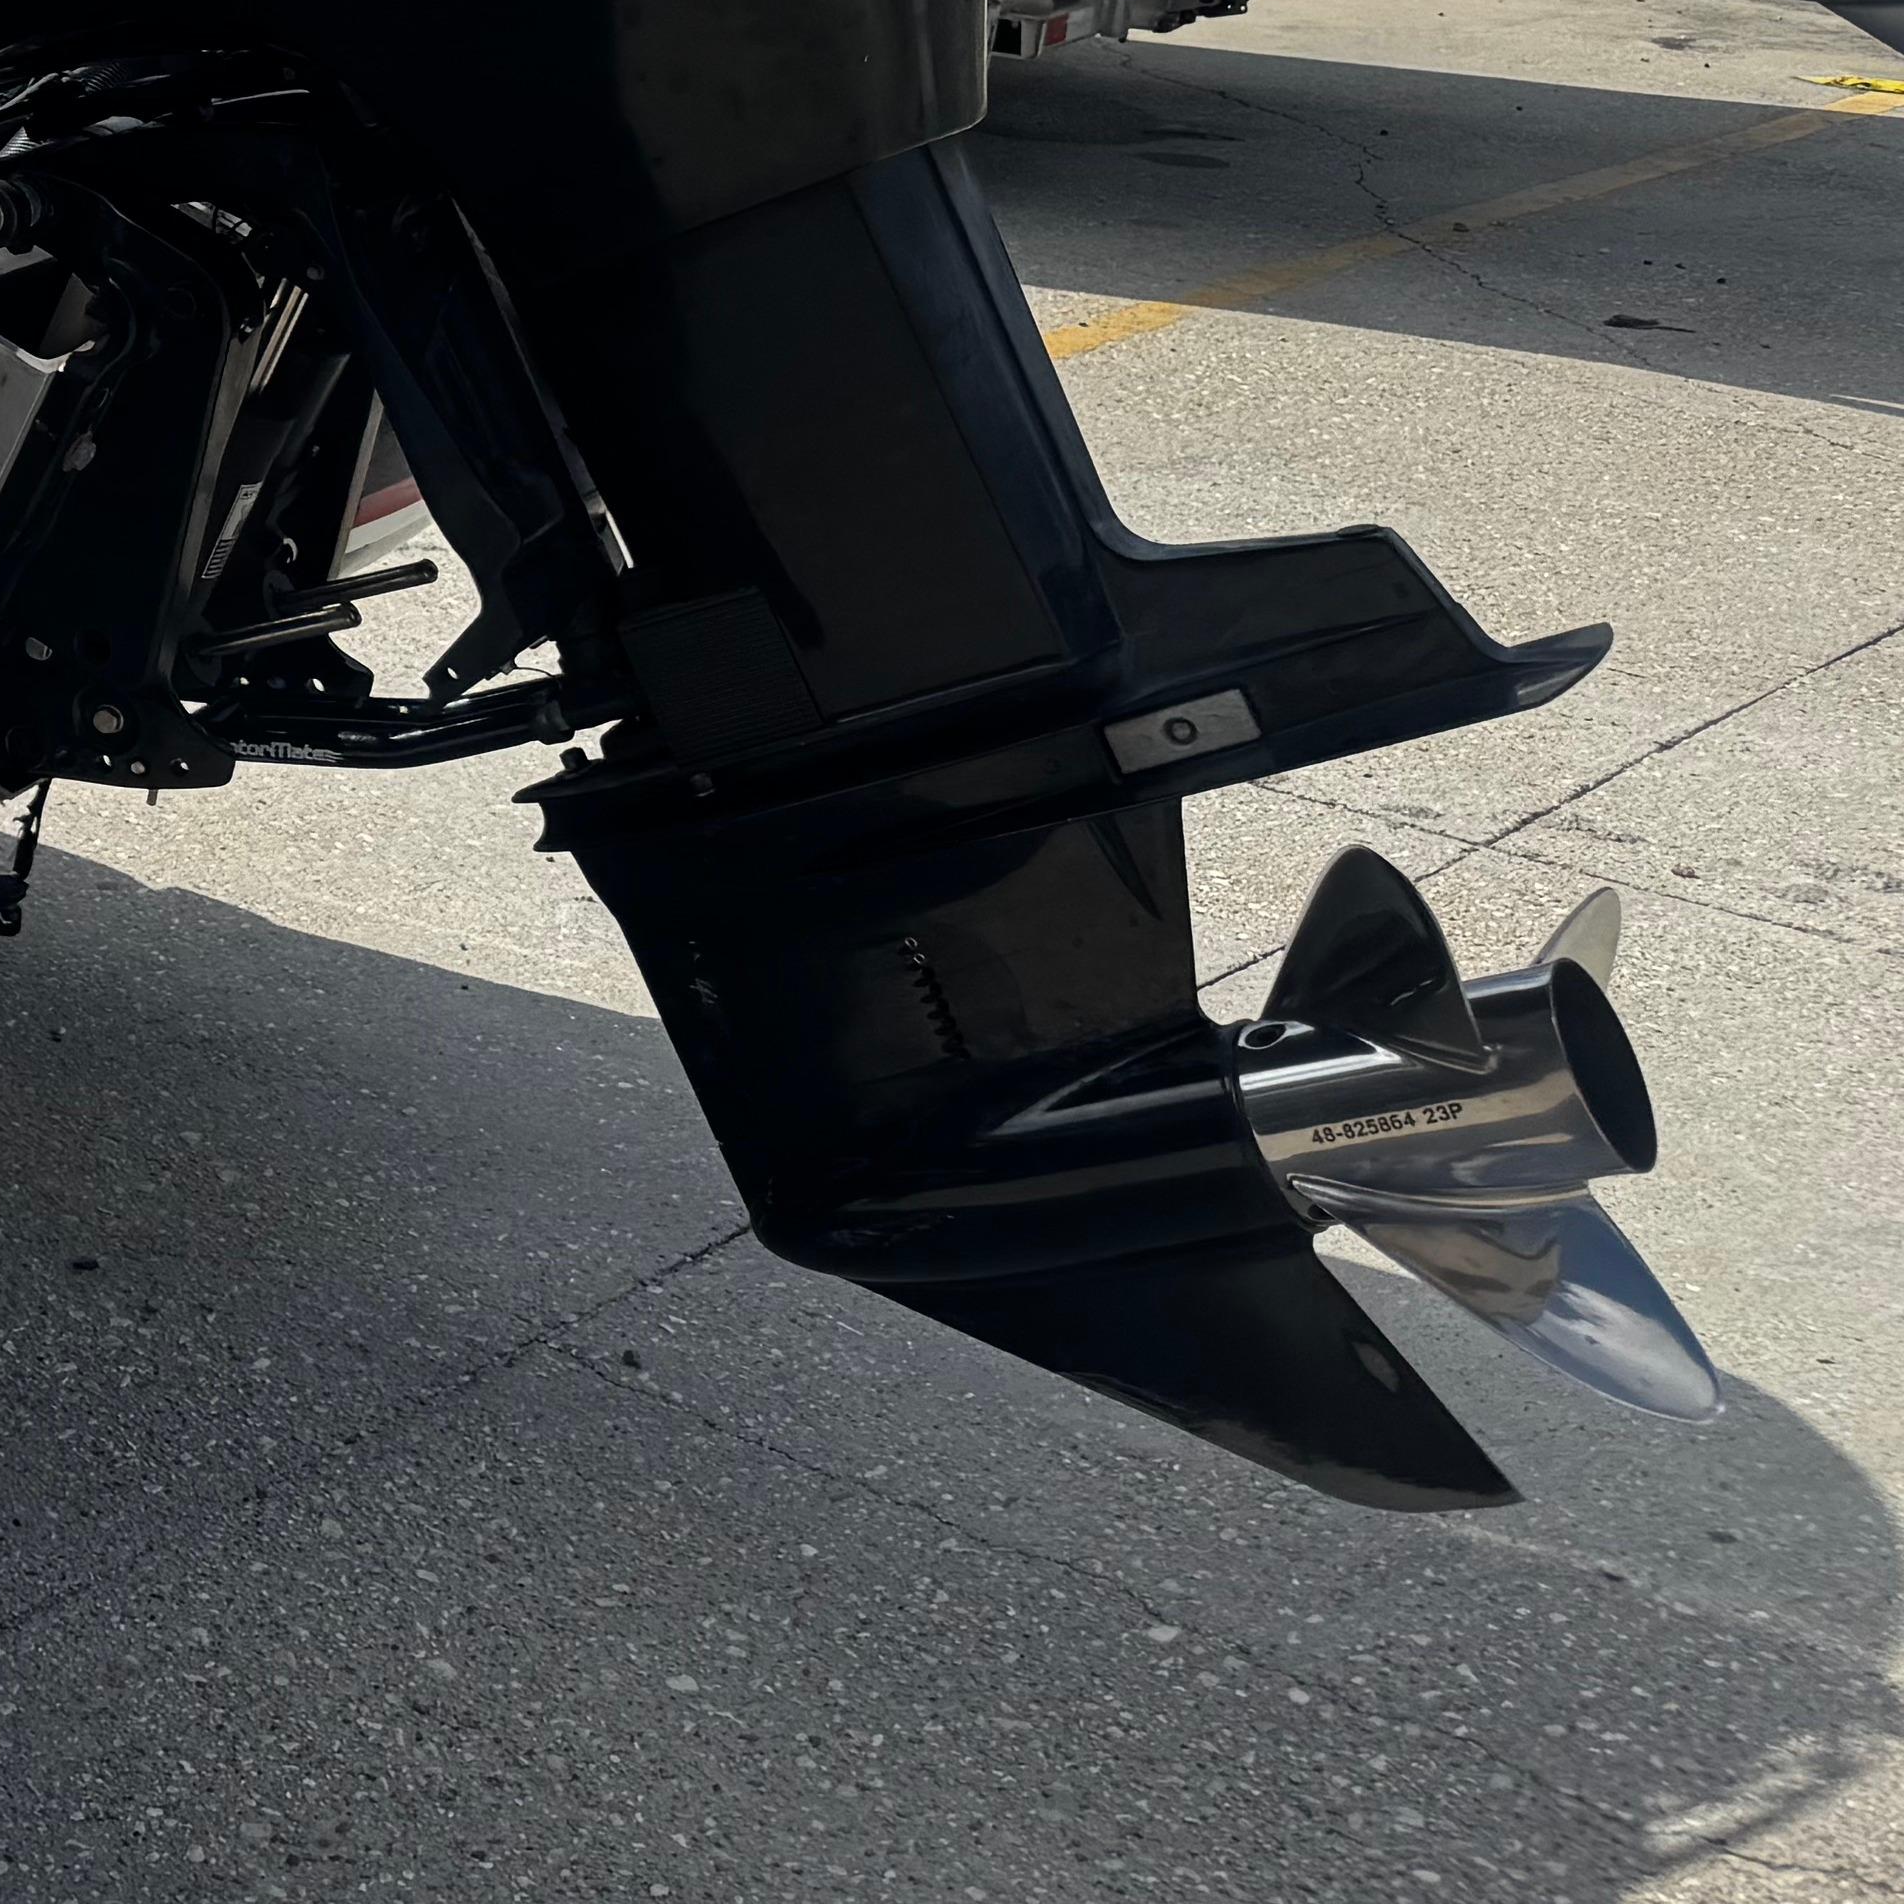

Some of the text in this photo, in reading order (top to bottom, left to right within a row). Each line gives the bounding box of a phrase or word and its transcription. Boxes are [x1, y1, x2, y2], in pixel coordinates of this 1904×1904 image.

[229, 739, 326, 761] torMate
[1311, 1102, 1463, 1145] 48-825864 23P
